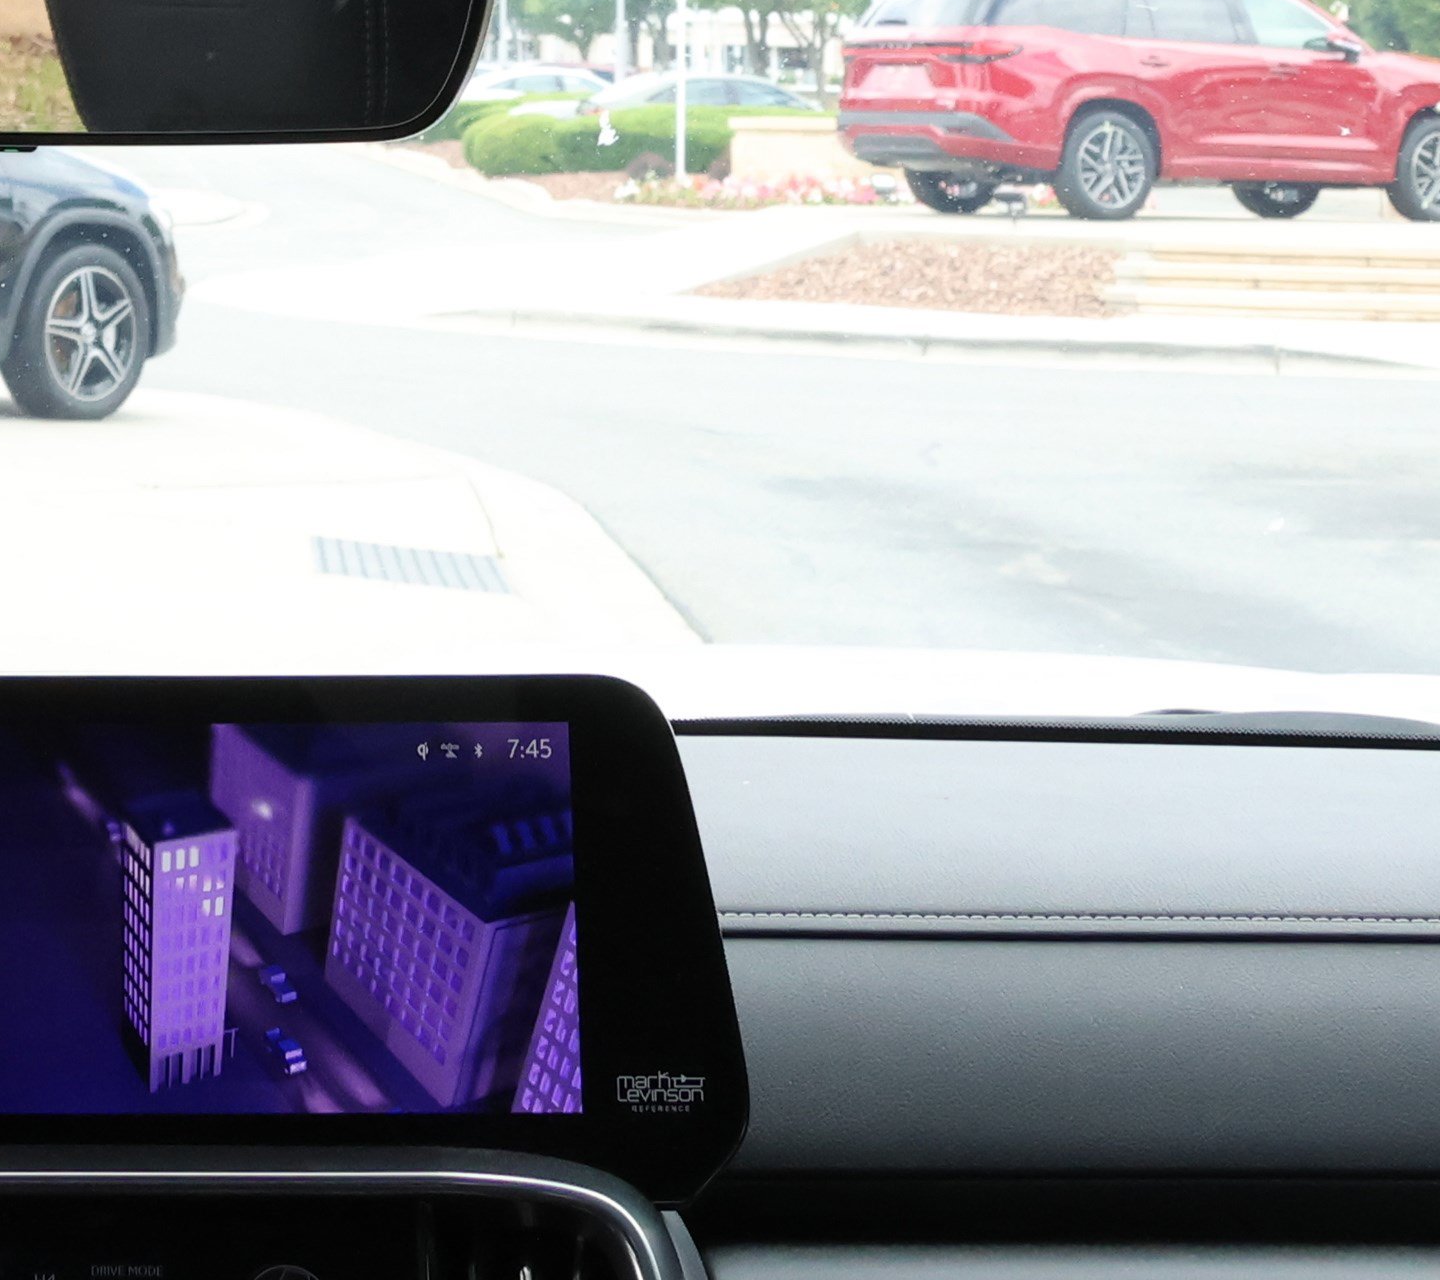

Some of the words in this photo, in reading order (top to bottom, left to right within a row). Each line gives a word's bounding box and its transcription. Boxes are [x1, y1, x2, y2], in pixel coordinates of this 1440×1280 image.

[506, 737, 553, 759] 7:45
[616, 1070, 672, 1089] mark
[616, 1085, 705, 1103] Levinson
[631, 1104, 691, 1113] REFERENCE
[89, 1264, 125, 1277] DRIVE
[127, 1264, 164, 1277] MODE
